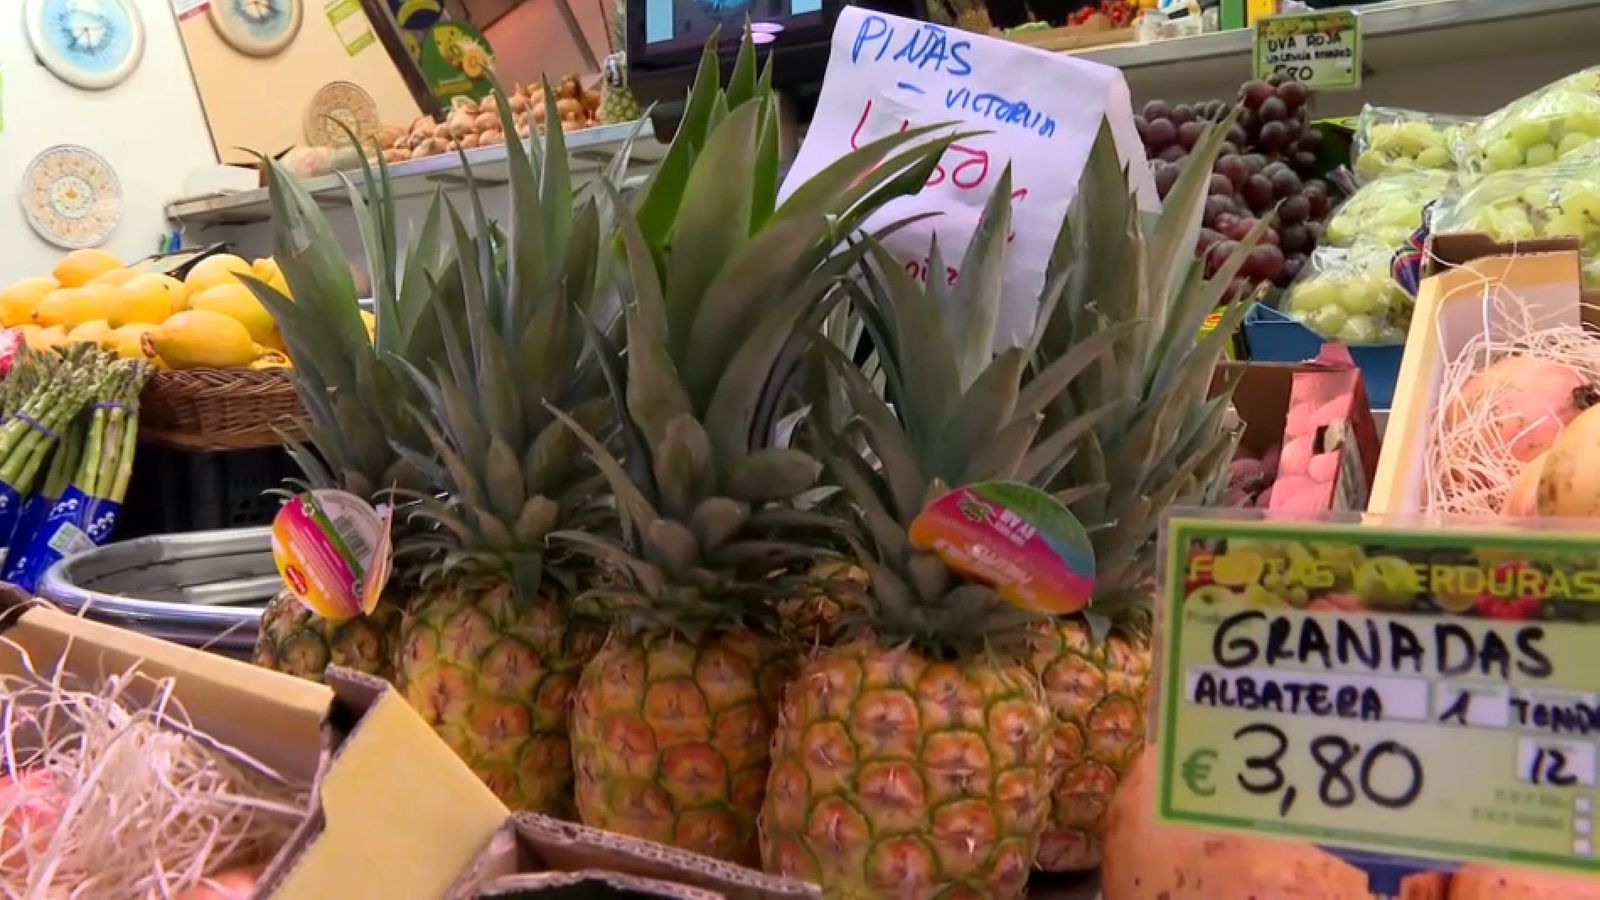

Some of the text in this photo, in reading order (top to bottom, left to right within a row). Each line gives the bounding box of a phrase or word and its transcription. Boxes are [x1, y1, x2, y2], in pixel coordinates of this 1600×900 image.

[852, 15, 972, 76] PIÑAS
[1212, 610, 1553, 679] GRANADAS
[1193, 672, 1383, 721] ALBATERA
[1440, 690, 1470, 725] 1
[1233, 723, 1424, 818] 3,80
[1530, 747, 1578, 787] 12
